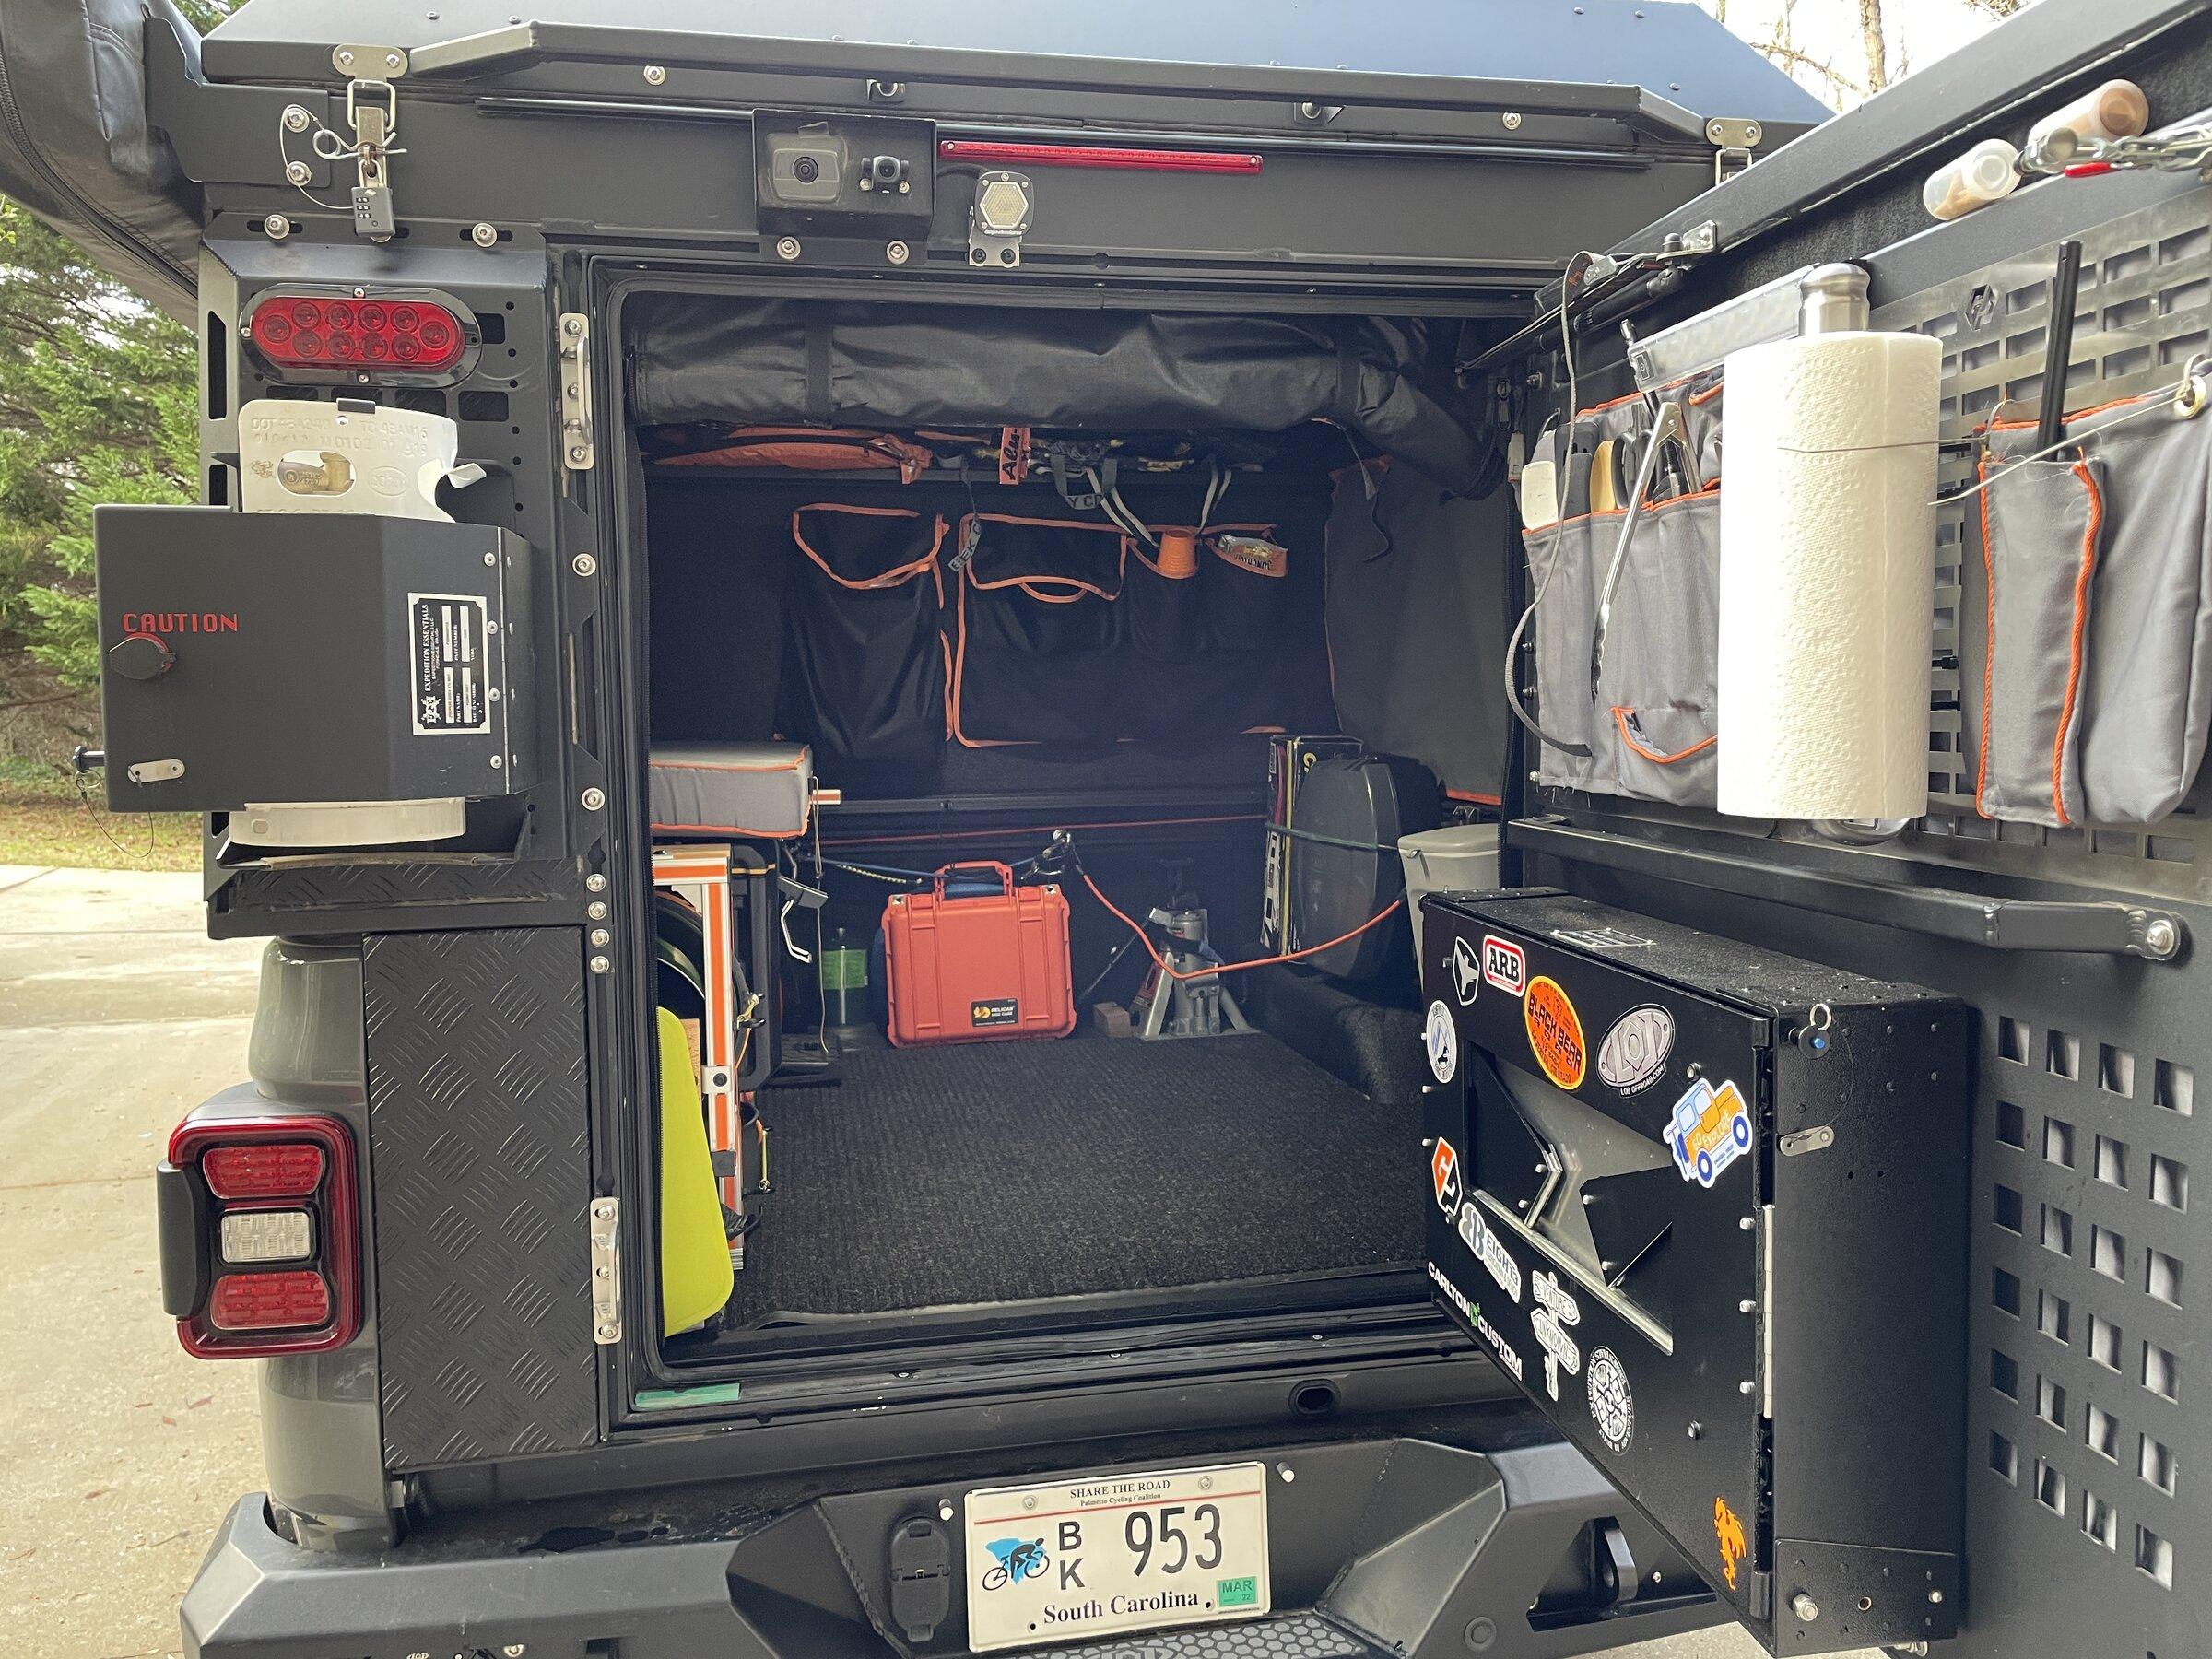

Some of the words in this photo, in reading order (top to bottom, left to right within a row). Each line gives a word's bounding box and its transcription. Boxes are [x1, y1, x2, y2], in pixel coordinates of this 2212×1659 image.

[122, 612, 239, 634] CAUTION
[421, 604, 429, 646] ESSENTIALS
[423, 647, 431, 691] EXPEDITION
[1489, 947, 1520, 982] ARB
[1528, 991, 1558, 1039] BLACK
[1558, 1026, 1583, 1077] BEAR
[1692, 1130, 1703, 1148] GO
[1701, 1111, 1731, 1148] EXPLORE
[1428, 1260, 1471, 1318] CARLTON
[1477, 1314, 1523, 1374] CUSTOM
[1070, 1486, 1109, 1499] SHARE
[1112, 1482, 1135, 1494] THE
[1138, 1479, 1171, 1491] ROAD
[1109, 1496, 1133, 1505] Cycling
[1134, 1493, 1161, 1501] Coalition
[1058, 1521, 1082, 1551] B
[1124, 1503, 1223, 1578] 953
[1059, 1557, 1086, 1591] K
[1222, 1580, 1253, 1594] MAR
[1043, 1598, 1104, 1625] South
[1110, 1591, 1199, 1615] Carolina
